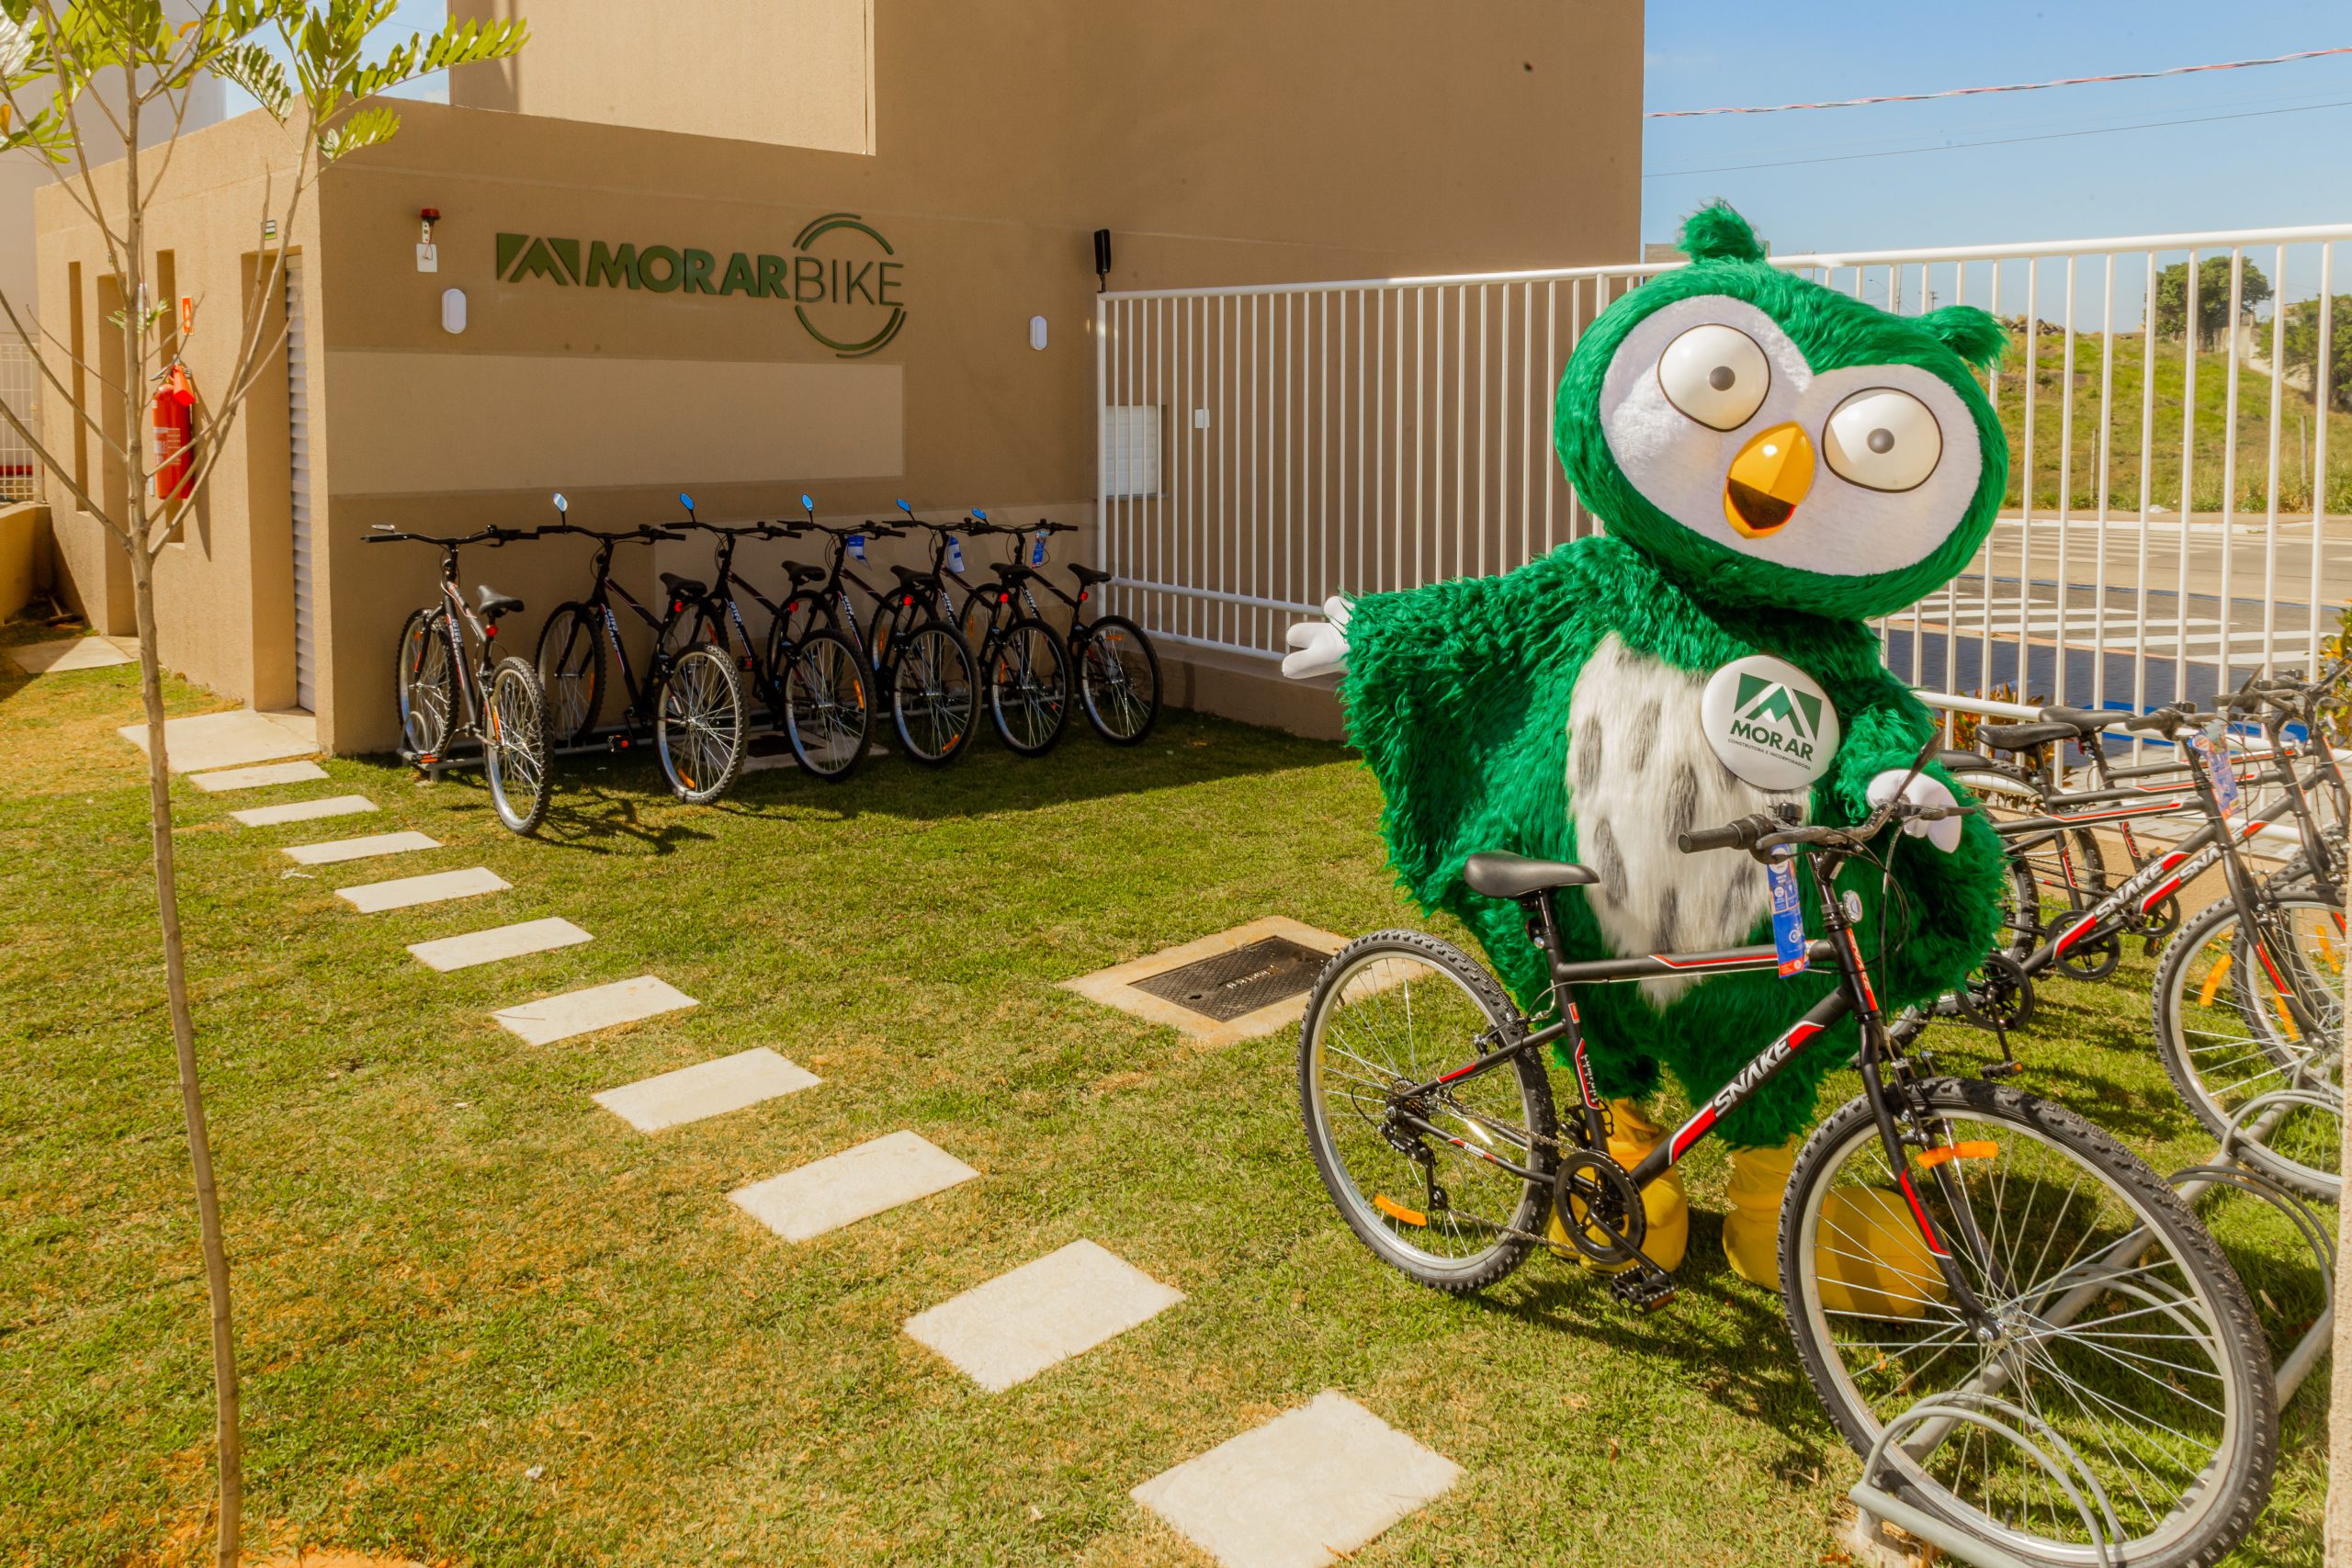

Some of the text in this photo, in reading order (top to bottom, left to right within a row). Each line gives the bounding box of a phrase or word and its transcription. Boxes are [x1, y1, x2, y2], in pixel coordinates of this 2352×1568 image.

[1727, 738, 1765, 754] CONSTRUTORA
[1729, 719, 1814, 762] MORAR
[2095, 861, 2164, 922] SNAKE
[1714, 1035, 1792, 1118] SNAKE
